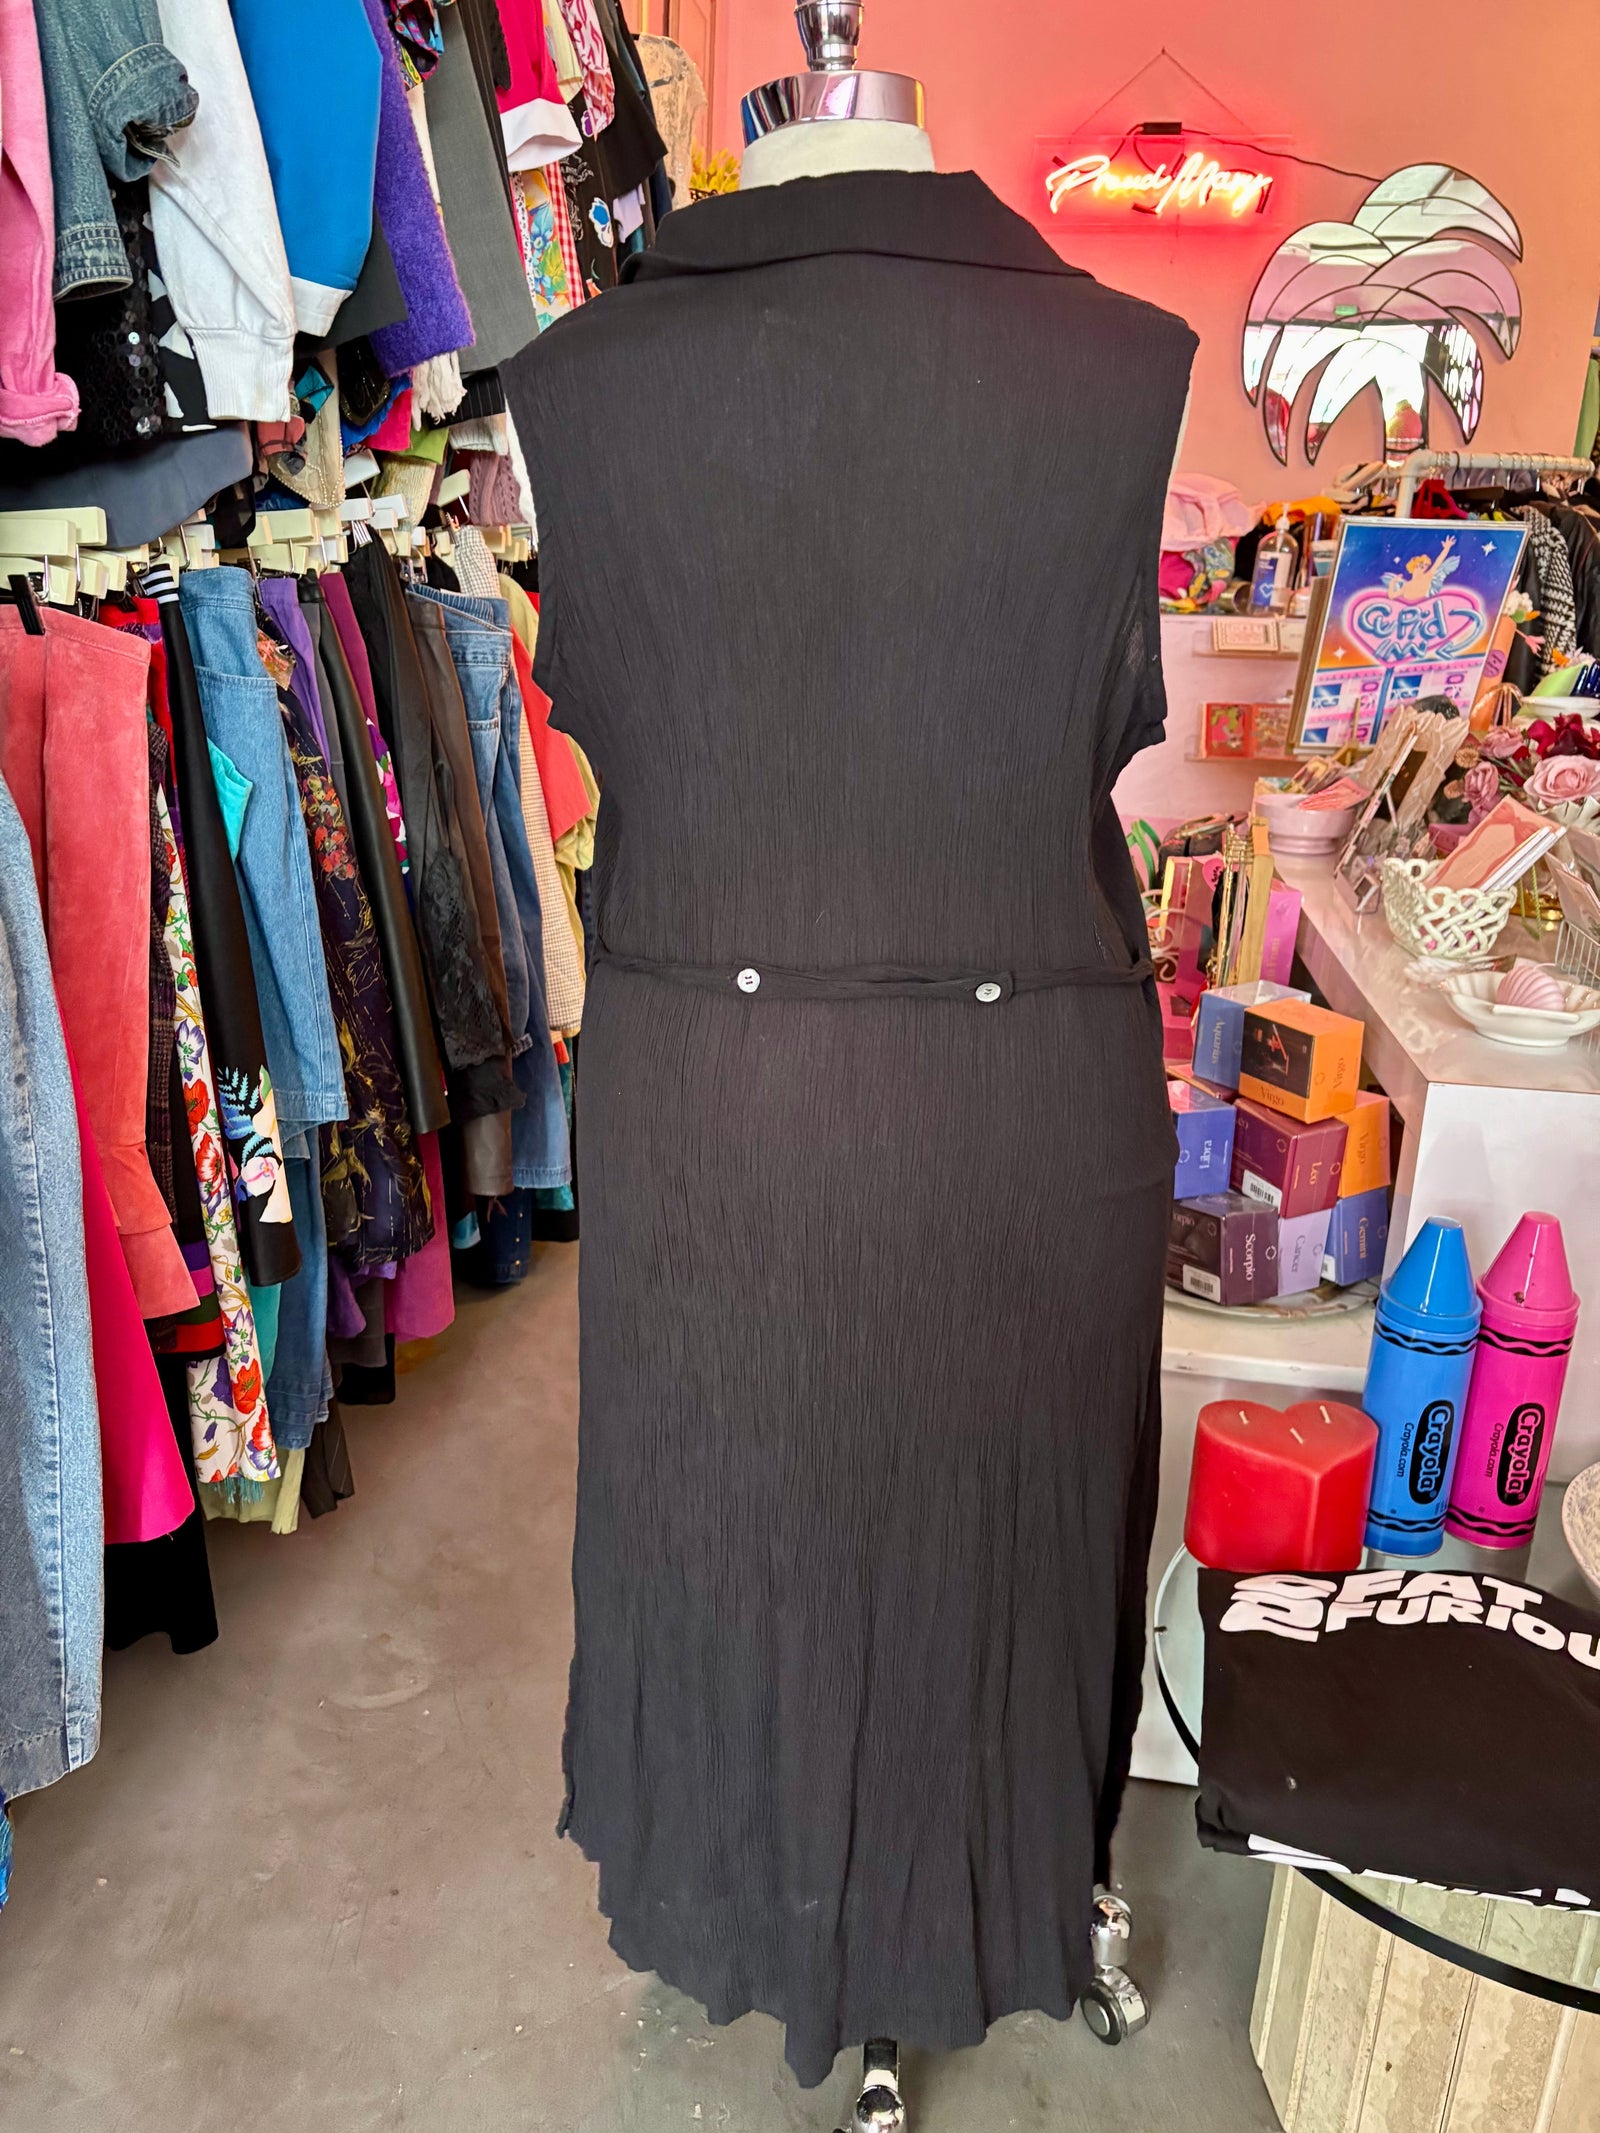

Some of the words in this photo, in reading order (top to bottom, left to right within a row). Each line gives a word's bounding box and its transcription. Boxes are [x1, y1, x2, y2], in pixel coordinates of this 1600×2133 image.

[1045, 154, 1171, 214] Proud
[1154, 151, 1273, 218] Mary
[1332, 1057, 1347, 1089] Virgo
[1260, 1085, 1285, 1106] Virgo
[1199, 1139, 1213, 1169] Libra
[1357, 1131, 1369, 1165] Virgo
[1309, 1161, 1323, 1185] Leo
[1243, 1233, 1256, 1281] Scorpio
[1291, 1235, 1306, 1273] Cancer
[1397, 1422, 1414, 1478] Crayola.com
[1485, 1422, 1504, 1478] Crayola.com
